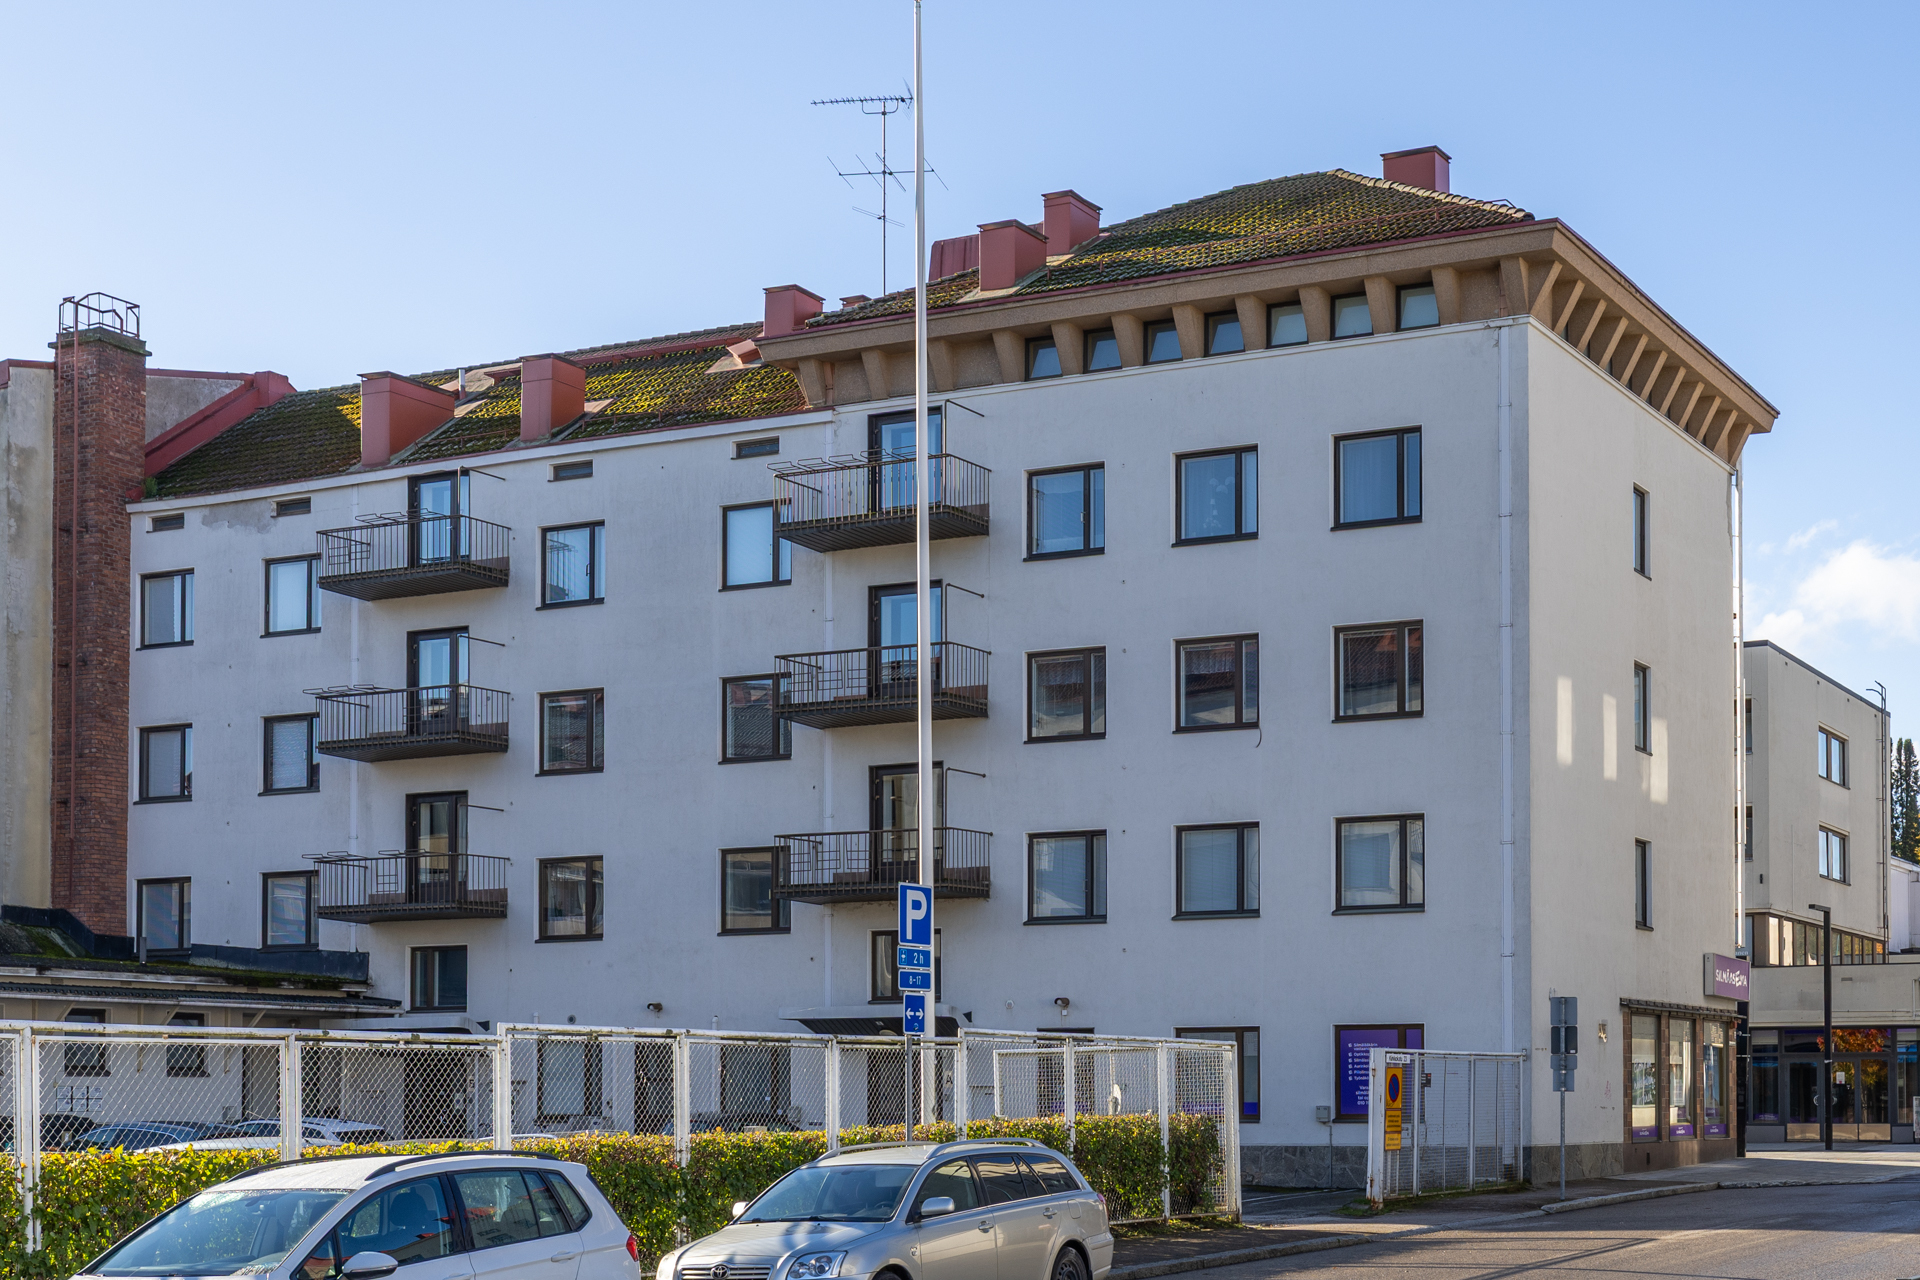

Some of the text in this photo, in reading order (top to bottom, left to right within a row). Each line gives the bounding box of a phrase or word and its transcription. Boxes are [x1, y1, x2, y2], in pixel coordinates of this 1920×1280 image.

[906, 889, 928, 940] P
[913, 952, 924, 965] 2 h
[909, 975, 922, 985] 8-17
